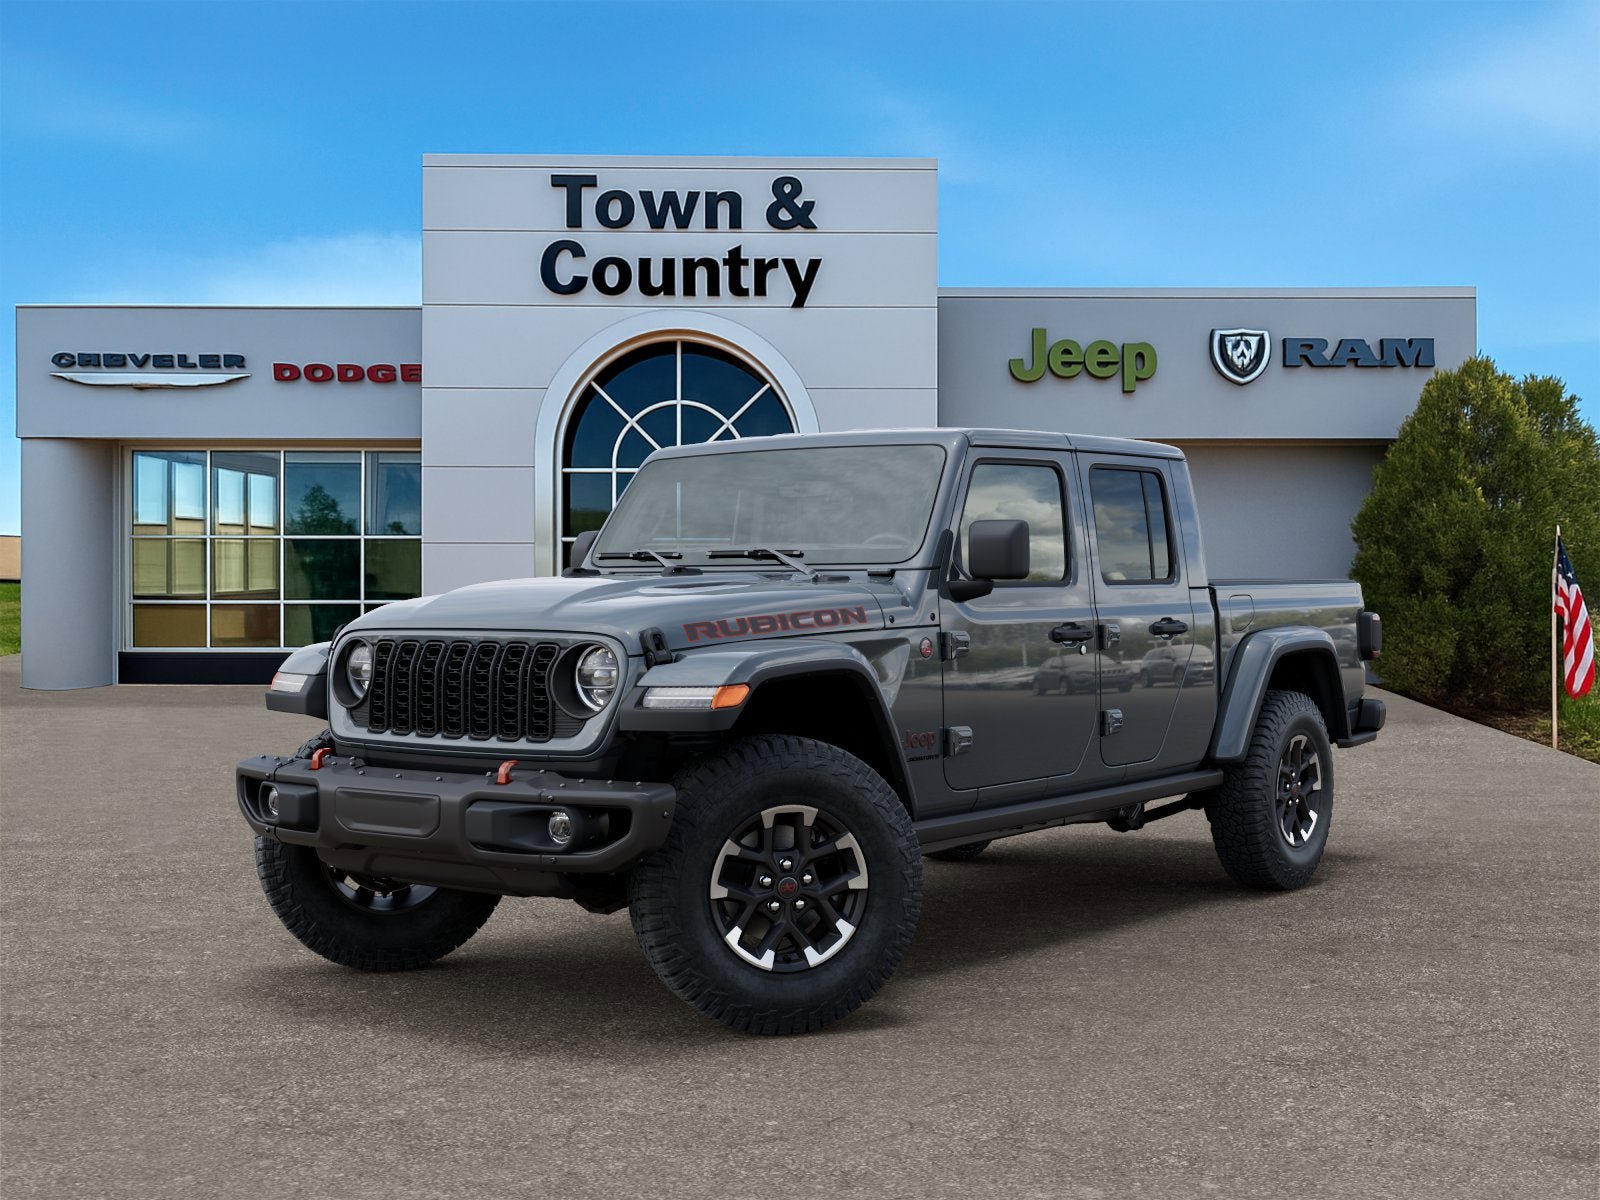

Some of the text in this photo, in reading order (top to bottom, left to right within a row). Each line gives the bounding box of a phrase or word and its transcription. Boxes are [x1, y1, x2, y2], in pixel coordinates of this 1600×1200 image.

[551, 174, 818, 230] Town &
[540, 239, 822, 309] Country
[273, 363, 422, 383] DODGE
[1008, 327, 1157, 393] Jeep
[1283, 337, 1436, 368] RAM
[682, 605, 867, 642] RUBICON
